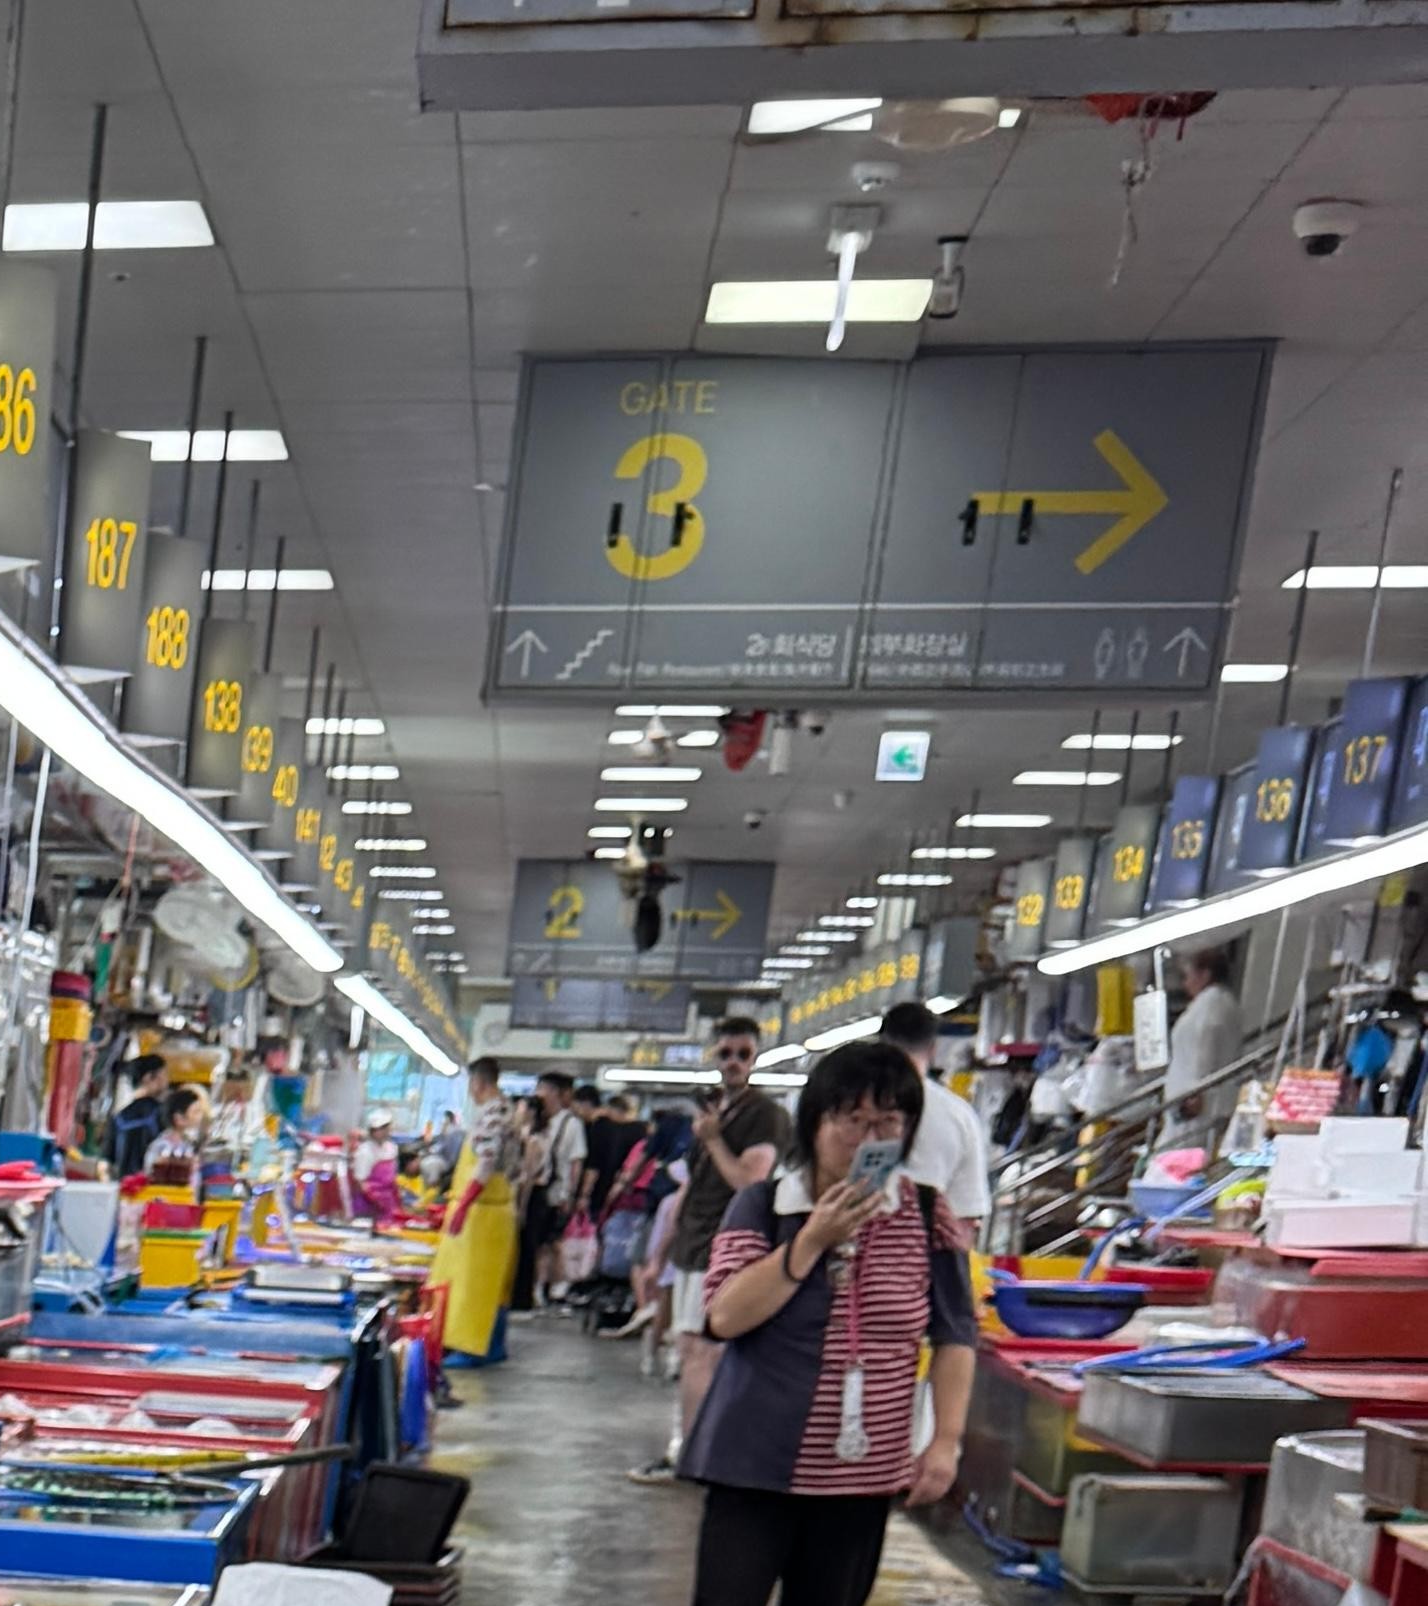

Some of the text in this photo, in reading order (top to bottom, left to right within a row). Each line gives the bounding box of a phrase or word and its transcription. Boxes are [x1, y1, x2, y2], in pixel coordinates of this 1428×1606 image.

[620, 381, 719, 417] GATE
[606, 433, 709, 582] 3
[85, 518, 138, 590] 187
[147, 606, 190, 670] 188
[204, 680, 243, 733] 138
[1344, 735, 1388, 784] 137
[1256, 777, 1294, 822] 136
[545, 886, 584, 938] 2
